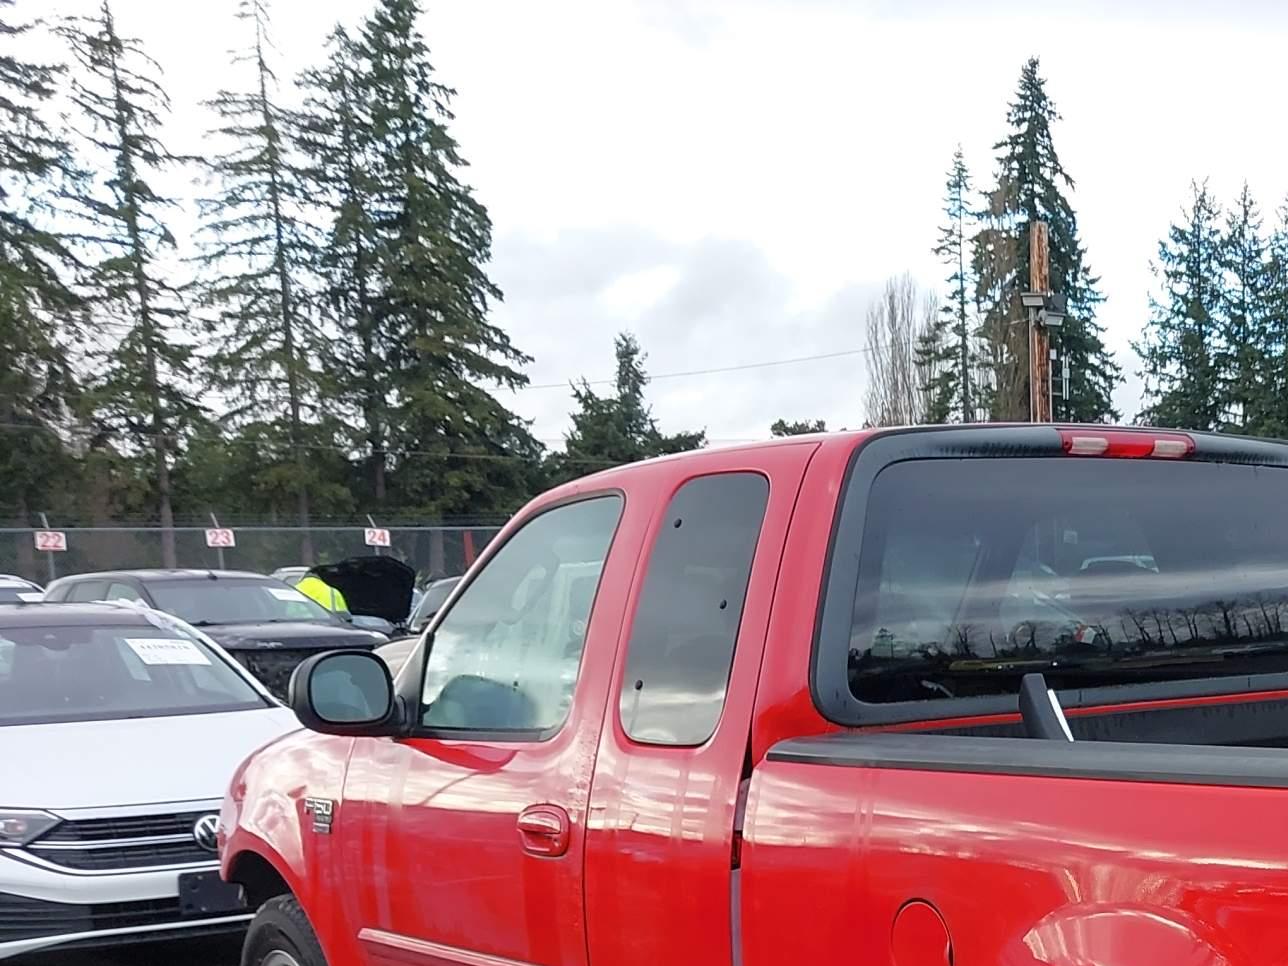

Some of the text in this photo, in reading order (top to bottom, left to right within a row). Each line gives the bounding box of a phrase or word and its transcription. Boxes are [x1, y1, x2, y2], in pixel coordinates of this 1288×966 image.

[38, 532, 64, 548] 22
[209, 529, 231, 545] 23
[367, 529, 387, 545] 24
